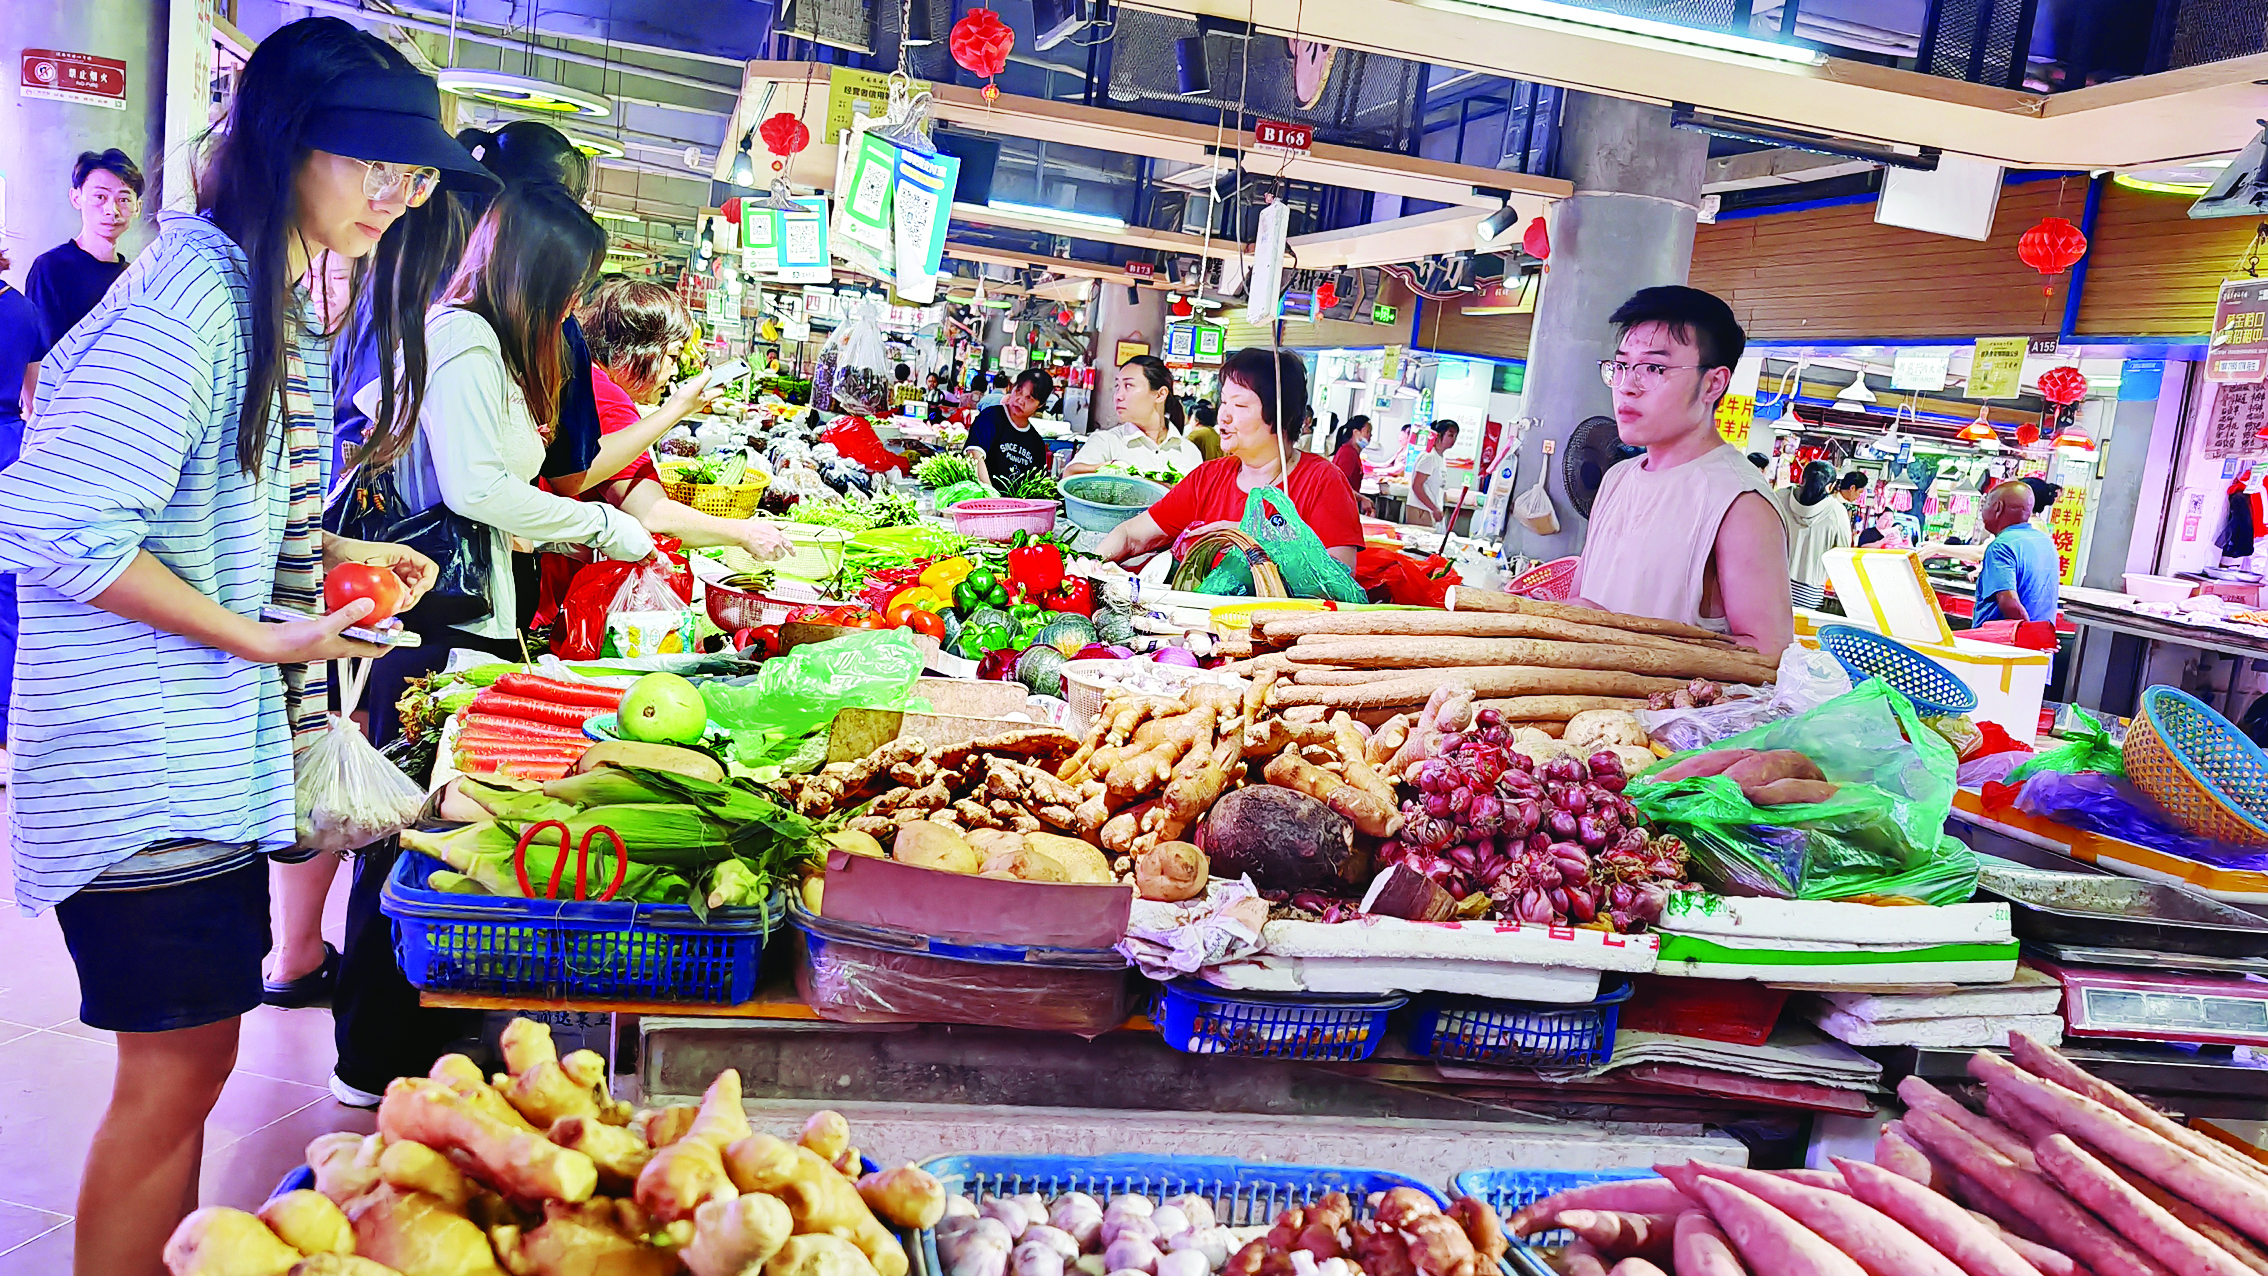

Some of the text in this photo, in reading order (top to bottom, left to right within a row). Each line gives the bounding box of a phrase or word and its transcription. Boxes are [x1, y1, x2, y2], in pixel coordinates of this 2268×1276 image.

[1263, 127, 1305, 146] B168
[1130, 264, 1151, 275] B173
[2031, 341, 2056, 353] A155
[2050, 507, 2083, 527] 肥羊片
